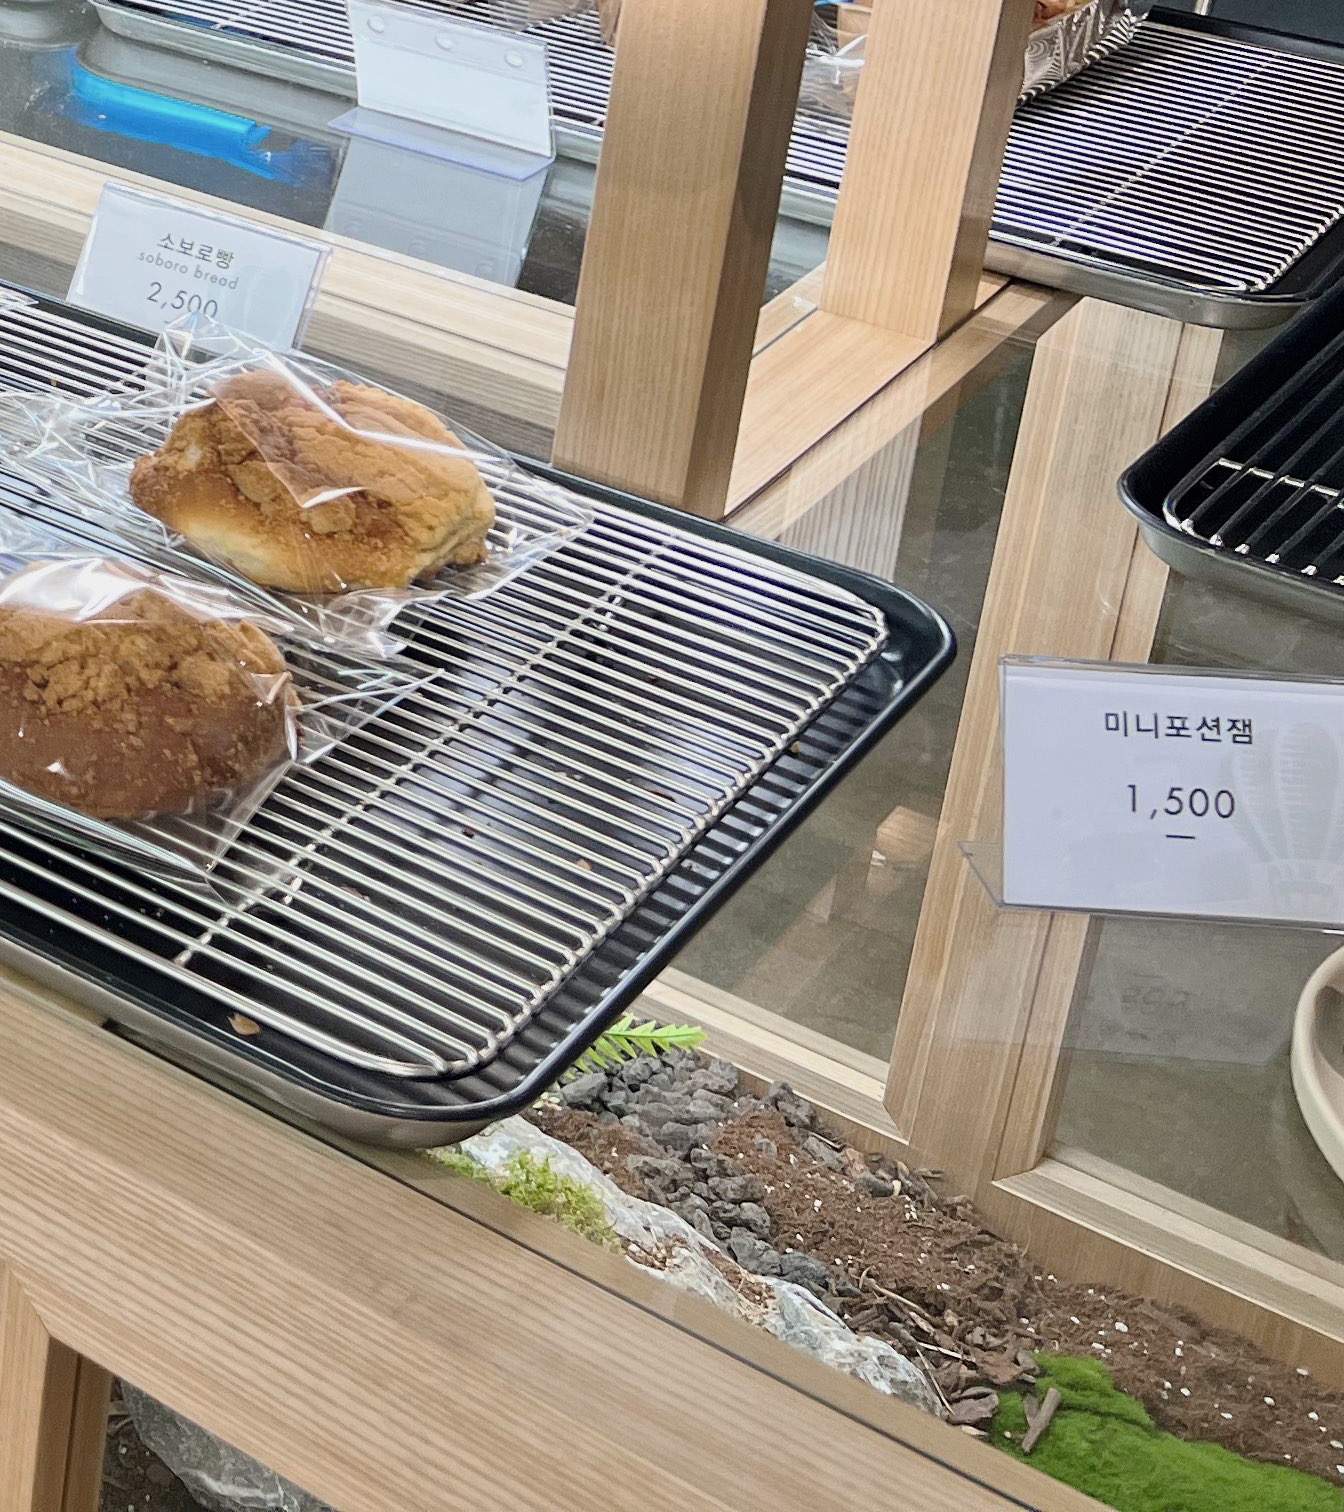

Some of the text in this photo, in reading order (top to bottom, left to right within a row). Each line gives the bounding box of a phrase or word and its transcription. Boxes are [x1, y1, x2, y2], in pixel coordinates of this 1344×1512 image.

[157, 232, 234, 270] 소보로빵
[138, 250, 239, 290] soboro bread
[146, 282, 219, 318] 2,500
[1104, 710, 1254, 745] 미니포션잼
[1127, 784, 1236, 820] 1,500
